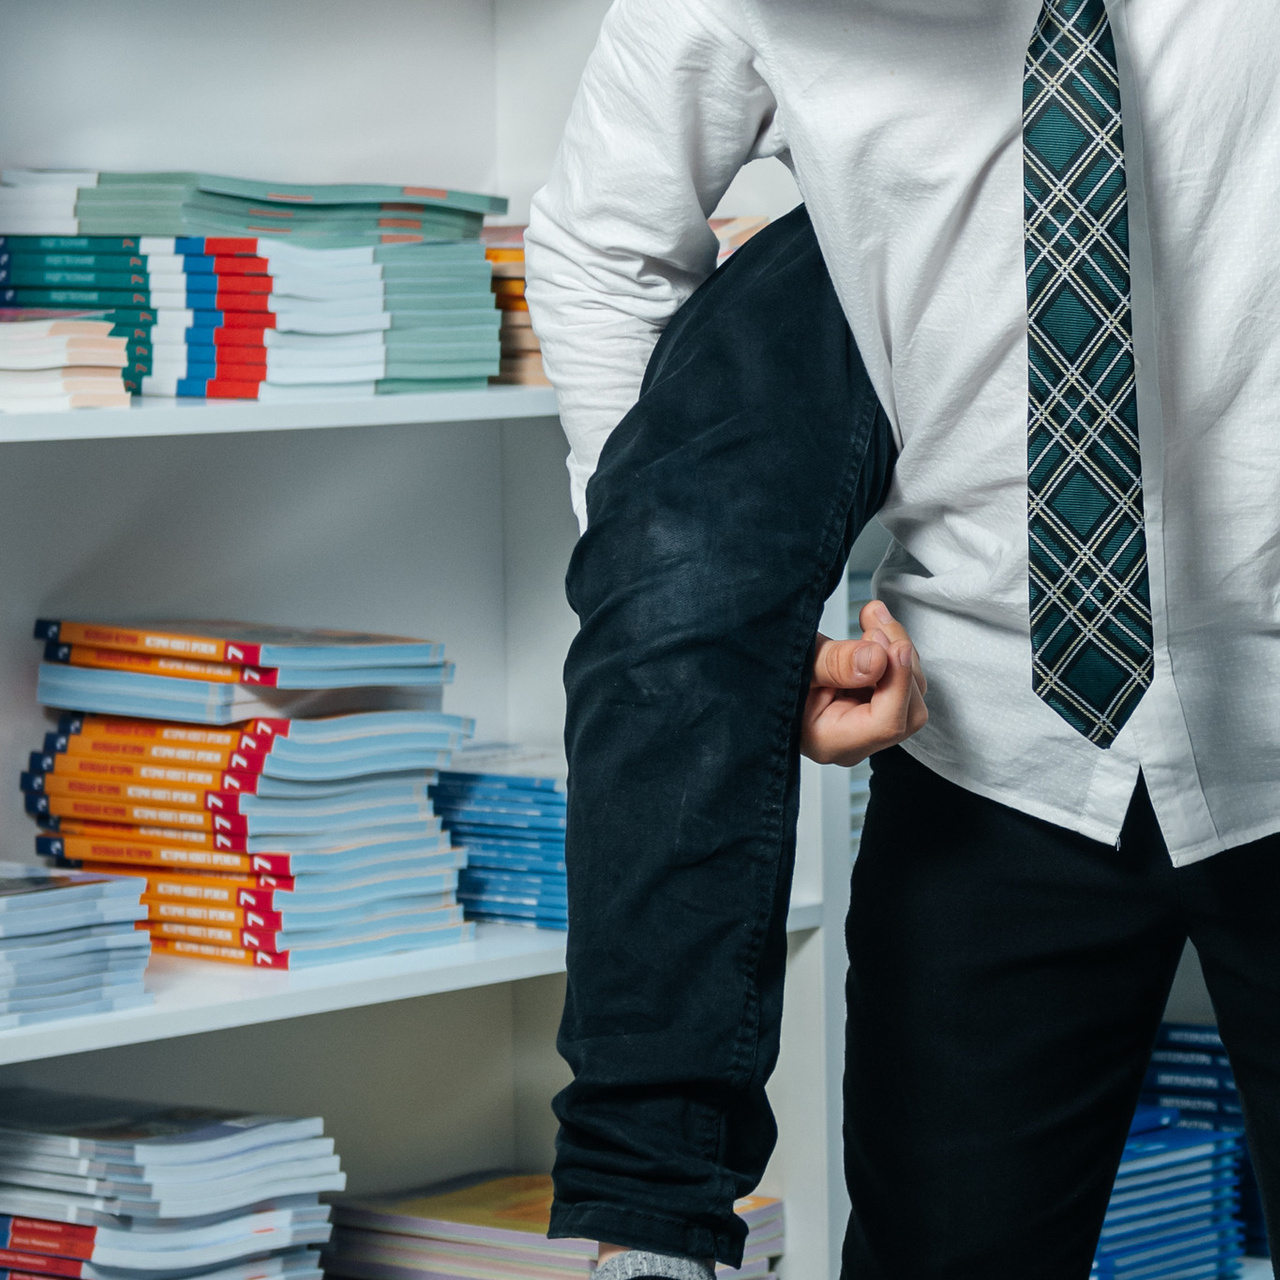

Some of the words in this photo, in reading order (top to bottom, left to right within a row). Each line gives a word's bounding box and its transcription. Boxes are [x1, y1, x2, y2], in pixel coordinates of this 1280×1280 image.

[227, 645, 244, 660] 7
[244, 667, 260, 681] 7
[257, 721, 273, 736] 7
[241, 735, 257, 750] 7
[231, 753, 248, 769] 7
[224, 775, 240, 791] 7
[207, 795, 224, 810] 7
[215, 815, 232, 830] 7
[216, 834, 232, 848] 7
[253, 857, 272, 874] 7
[239, 891, 256, 907] 7
[247, 913, 265, 928] 7
[243, 932, 259, 948] 7
[256, 950, 273, 965] 7
